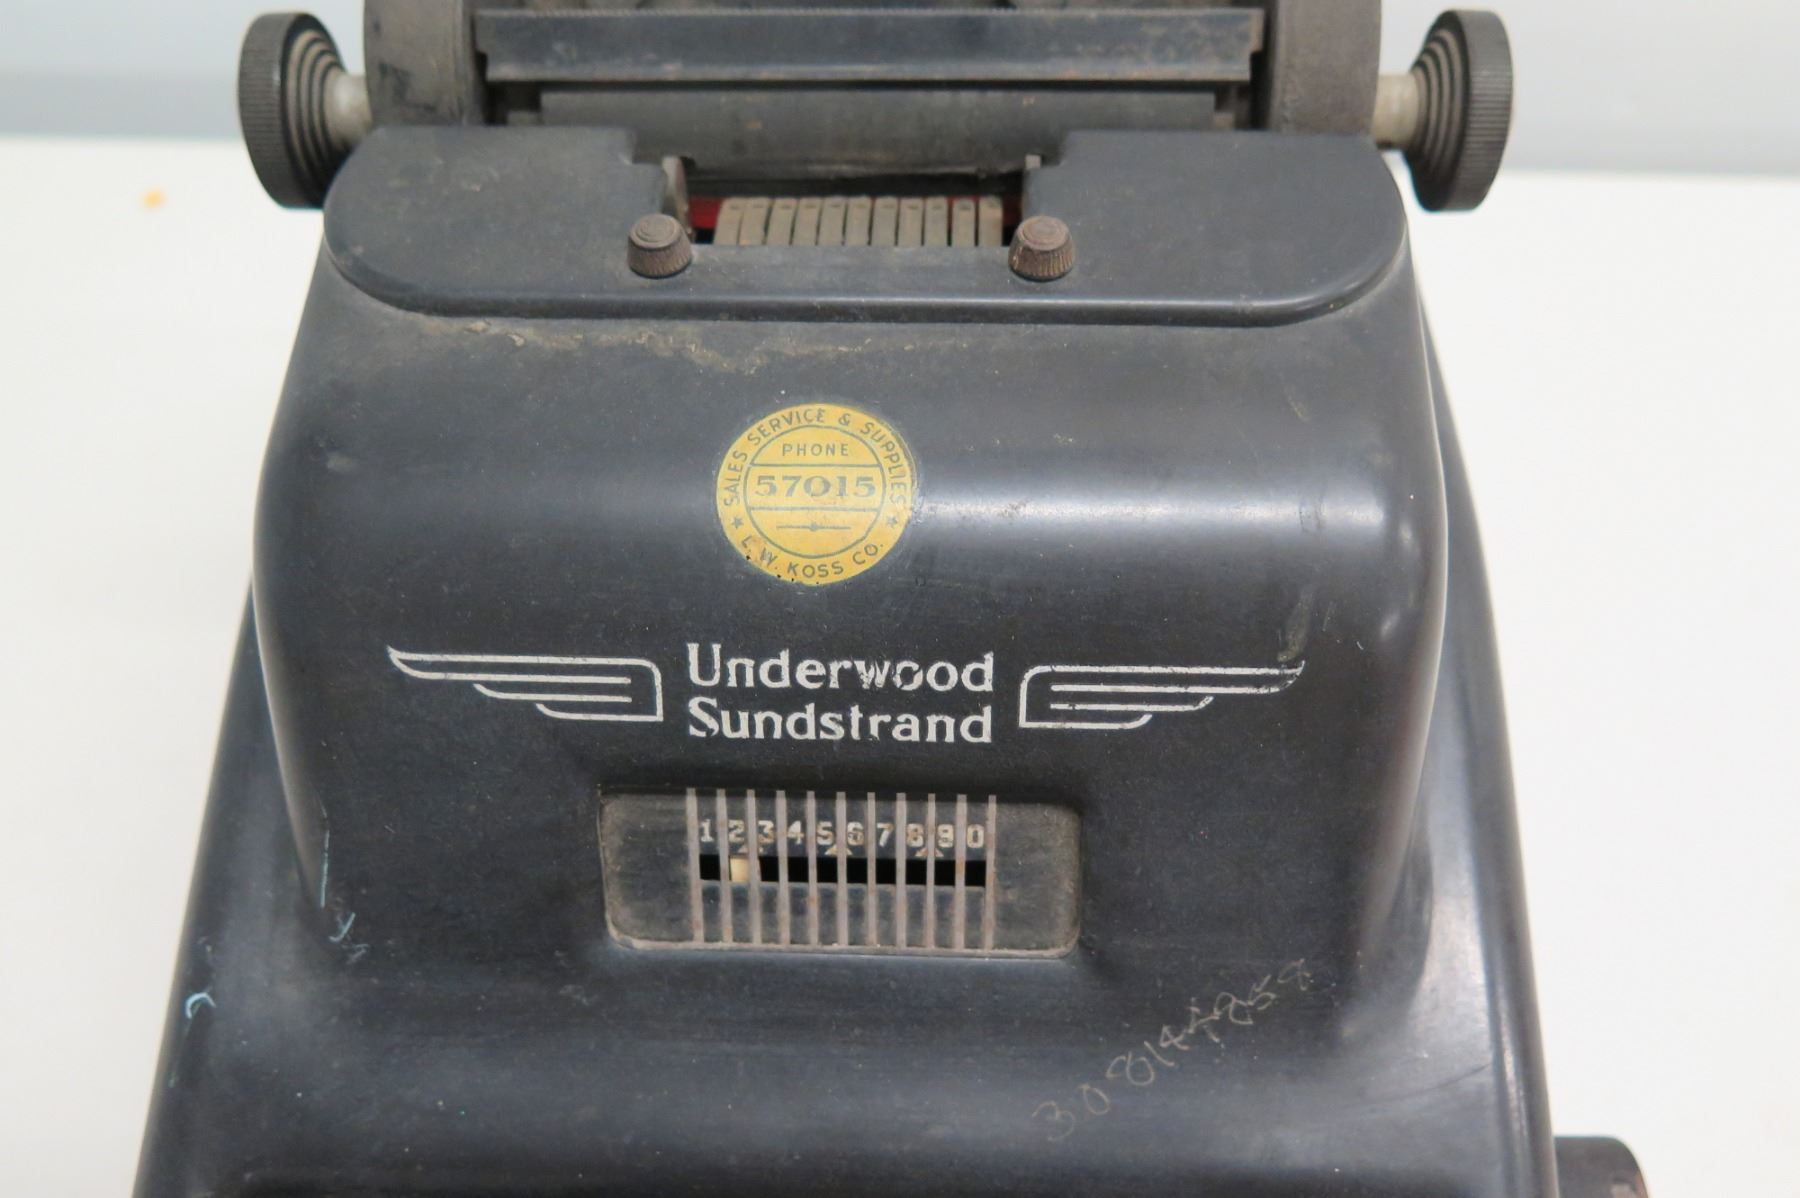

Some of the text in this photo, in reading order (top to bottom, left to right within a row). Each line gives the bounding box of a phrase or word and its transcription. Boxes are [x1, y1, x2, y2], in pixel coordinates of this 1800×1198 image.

[724, 408, 906, 506] SALES SERVICE & SUPPLIES
[782, 444, 848, 456] PHONE
[755, 475, 875, 497] 57015
[787, 561, 844, 578] KOSS
[852, 544, 883, 565] CO.
[687, 642, 994, 691] Underwood
[688, 696, 992, 743] Sundstrand
[700, 819, 714, 843] 1
[728, 819, 745, 845] 2
[758, 820, 774, 844] 3
[787, 821, 804, 845] 4
[816, 821, 834, 845] 5
[847, 822, 864, 846] 6
[877, 822, 893, 847] 7
[967, 824, 985, 848] 0
